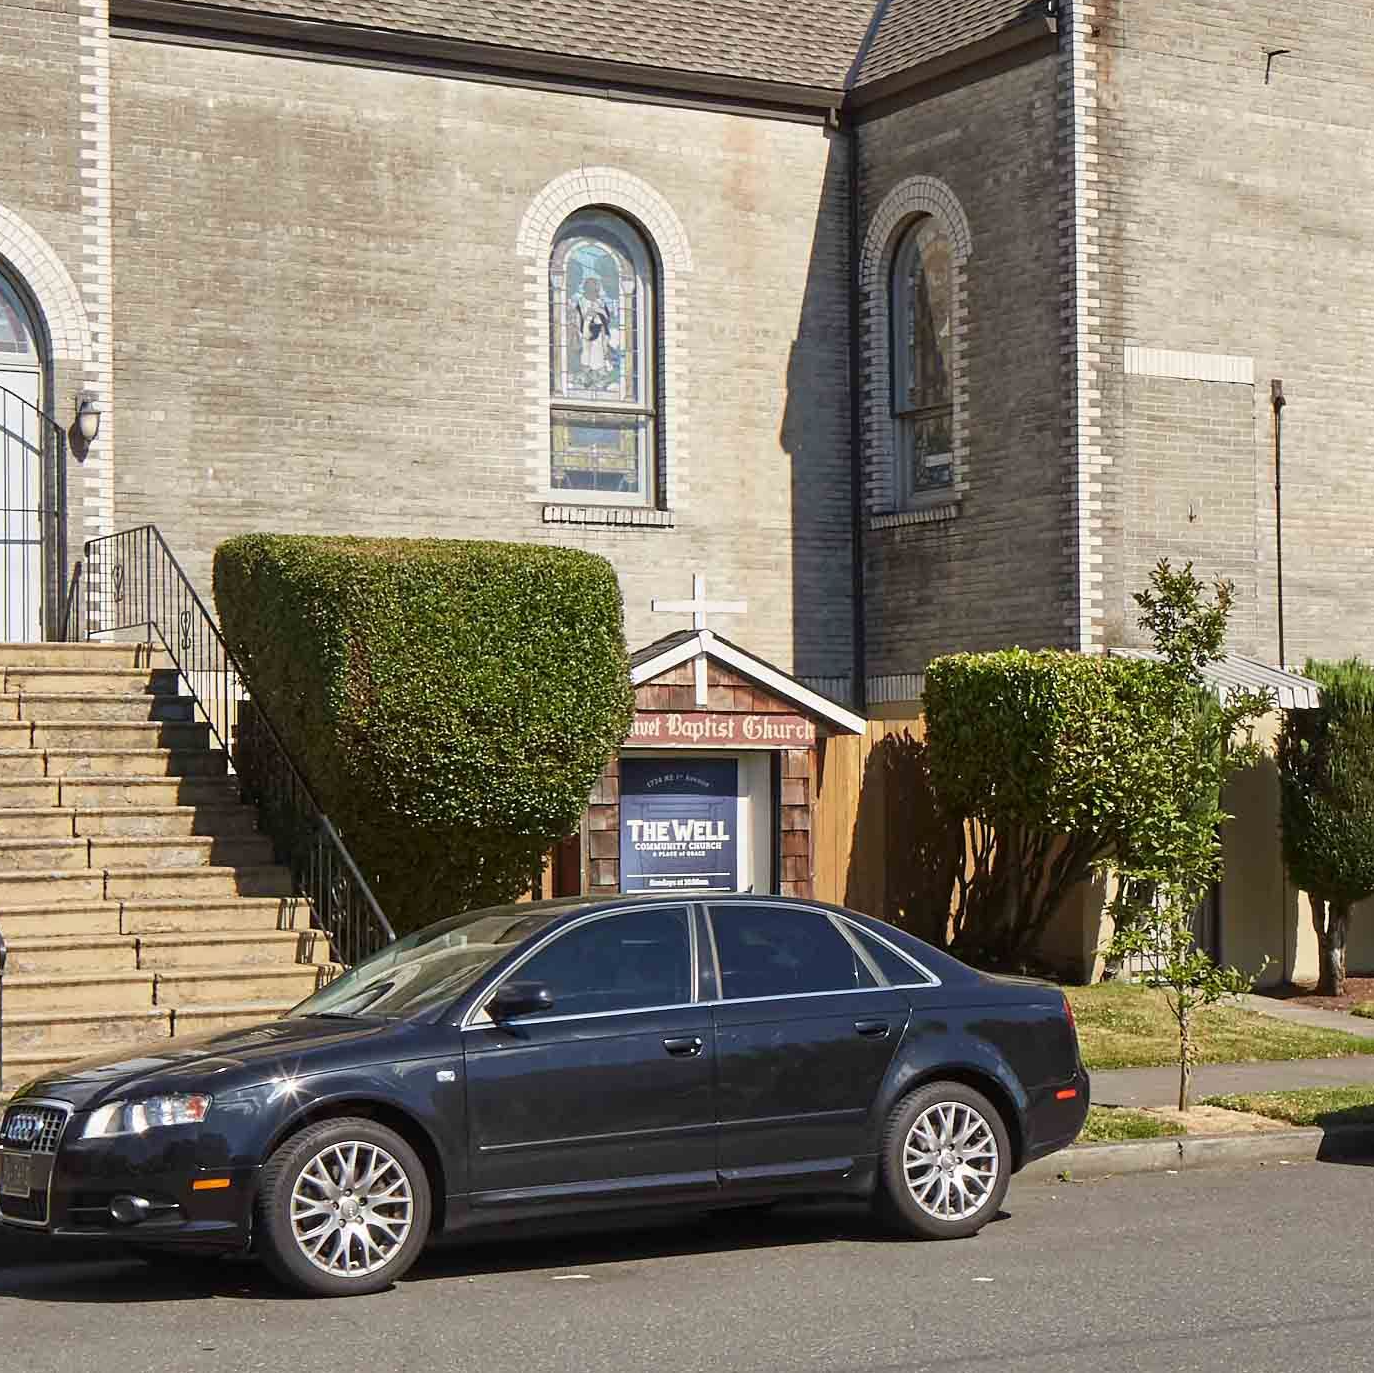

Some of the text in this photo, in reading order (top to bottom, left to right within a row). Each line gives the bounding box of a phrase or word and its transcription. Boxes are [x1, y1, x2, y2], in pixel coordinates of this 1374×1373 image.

[666, 713, 735, 742] Baptist
[742, 714, 816, 740] Church
[627, 819, 730, 842] THE WELL
[634, 842, 722, 851] COMMUNITY CHURCH
